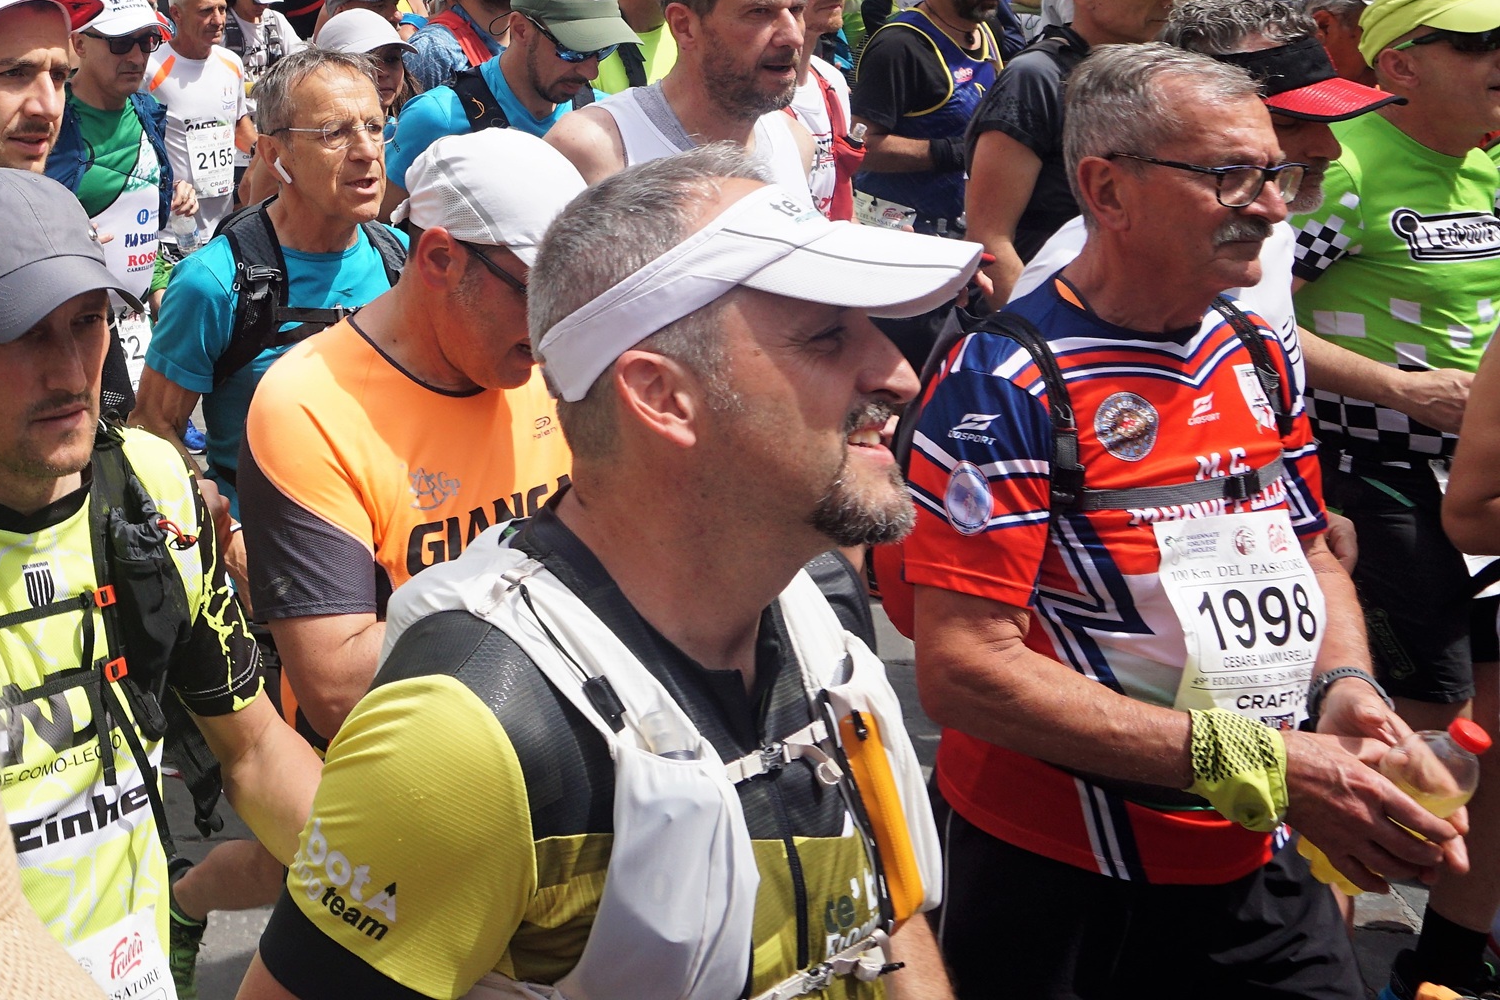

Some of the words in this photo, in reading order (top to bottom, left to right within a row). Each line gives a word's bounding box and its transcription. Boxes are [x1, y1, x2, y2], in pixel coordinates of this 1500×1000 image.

[196, 147, 234, 170] 2155
[1171, 569, 1188, 582] 100
[1190, 567, 1212, 579] Km
[1217, 564, 1242, 577] DEL
[1197, 582, 1317, 651] 1998
[1222, 653, 1257, 669] CESARE
[1211, 670, 1259, 686] EDIZIONE
[1236, 691, 1295, 710] CRAFT
[321, 886, 389, 941] team
